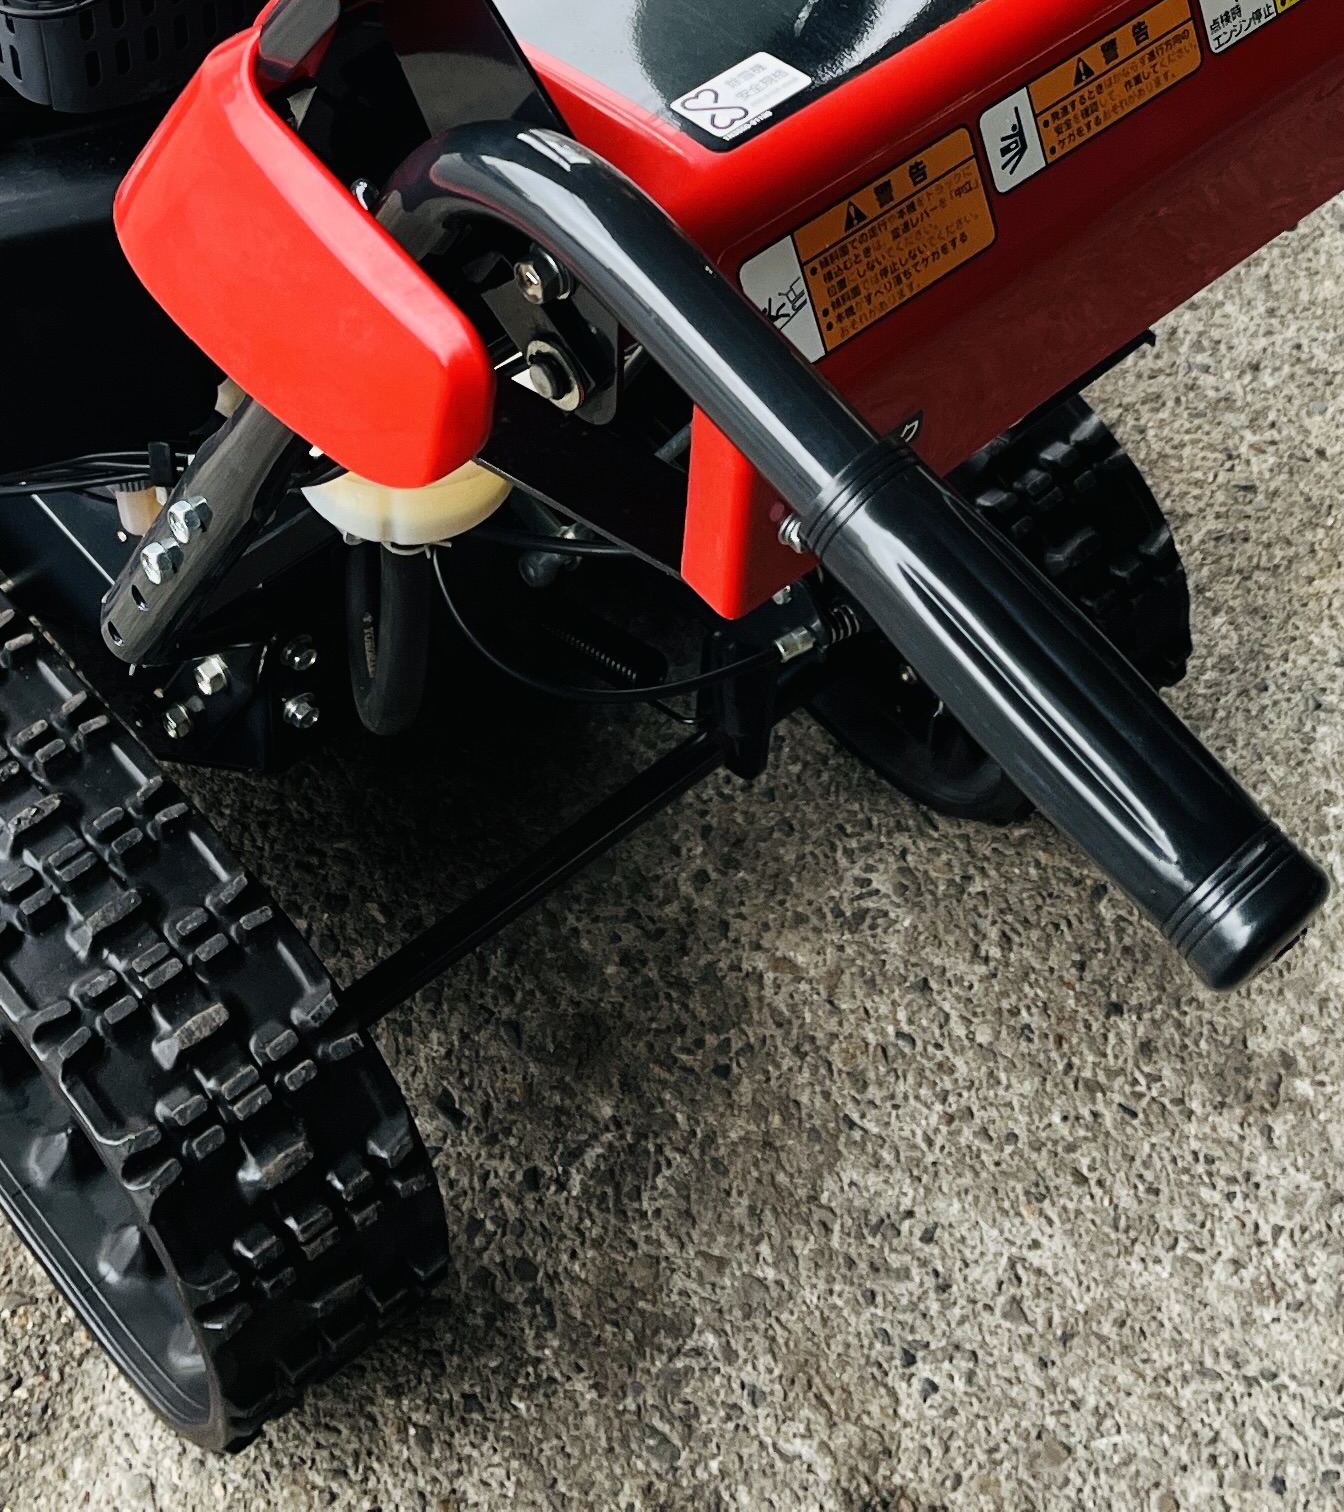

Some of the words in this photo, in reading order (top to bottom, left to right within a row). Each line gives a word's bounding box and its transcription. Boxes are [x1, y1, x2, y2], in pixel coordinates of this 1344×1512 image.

[1207, 3, 1243, 35] 点検時
[1210, 1, 1274, 50] エンジン停止
